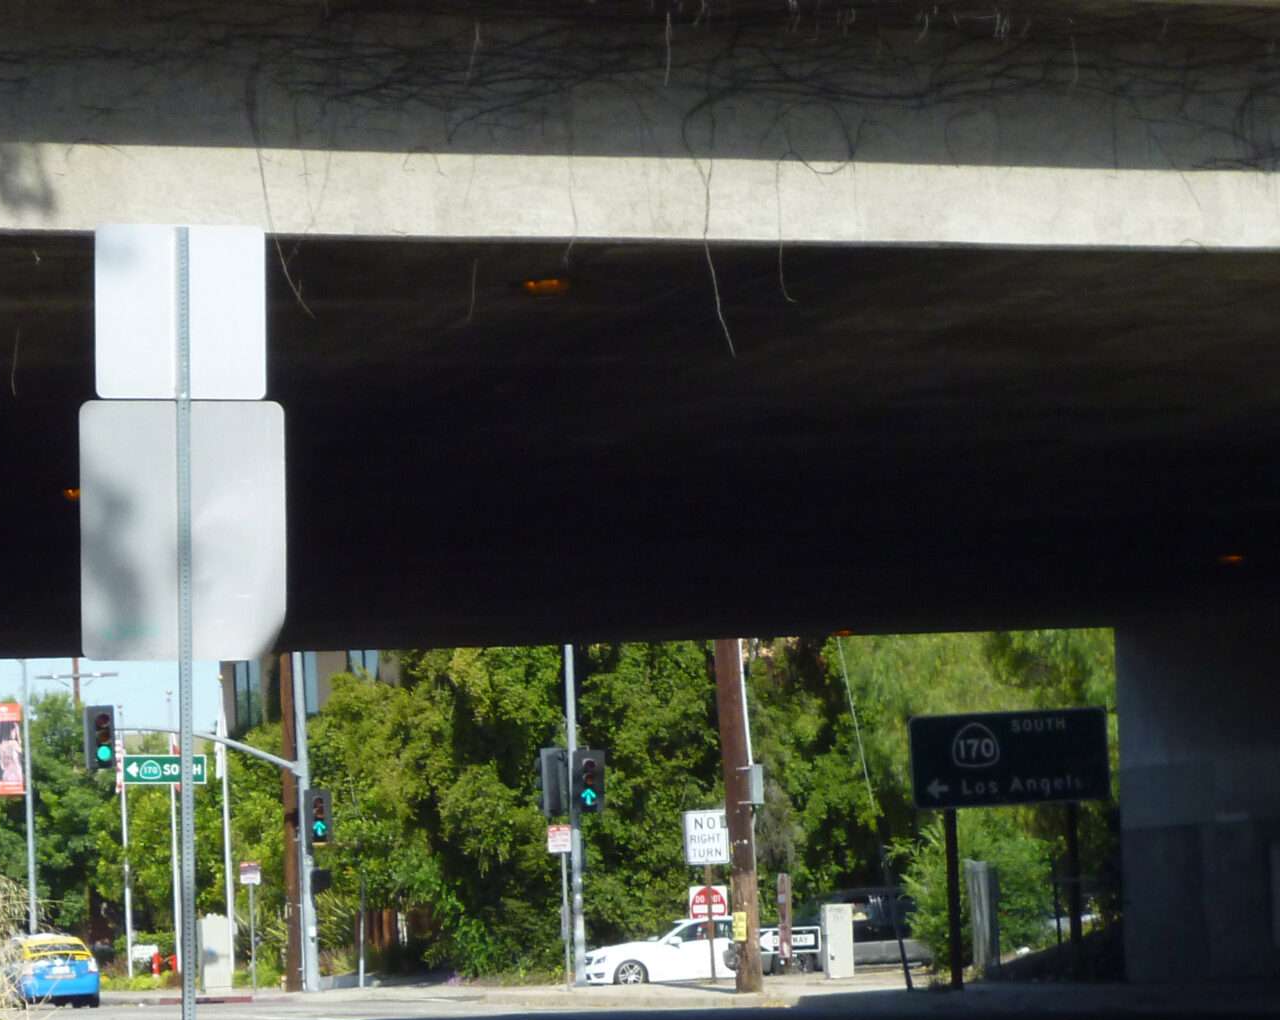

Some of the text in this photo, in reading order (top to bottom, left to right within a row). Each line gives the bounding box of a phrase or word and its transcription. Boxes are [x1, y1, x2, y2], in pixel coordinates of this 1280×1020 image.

[1010, 717, 1066, 733] SOUTH
[958, 738, 995, 760] 170
[162, 763, 202, 776] SOH
[961, 779, 999, 796] Los
[694, 817, 716, 830] NO
[689, 833, 721, 845] RIGHT
[692, 847, 722, 858] TURN
